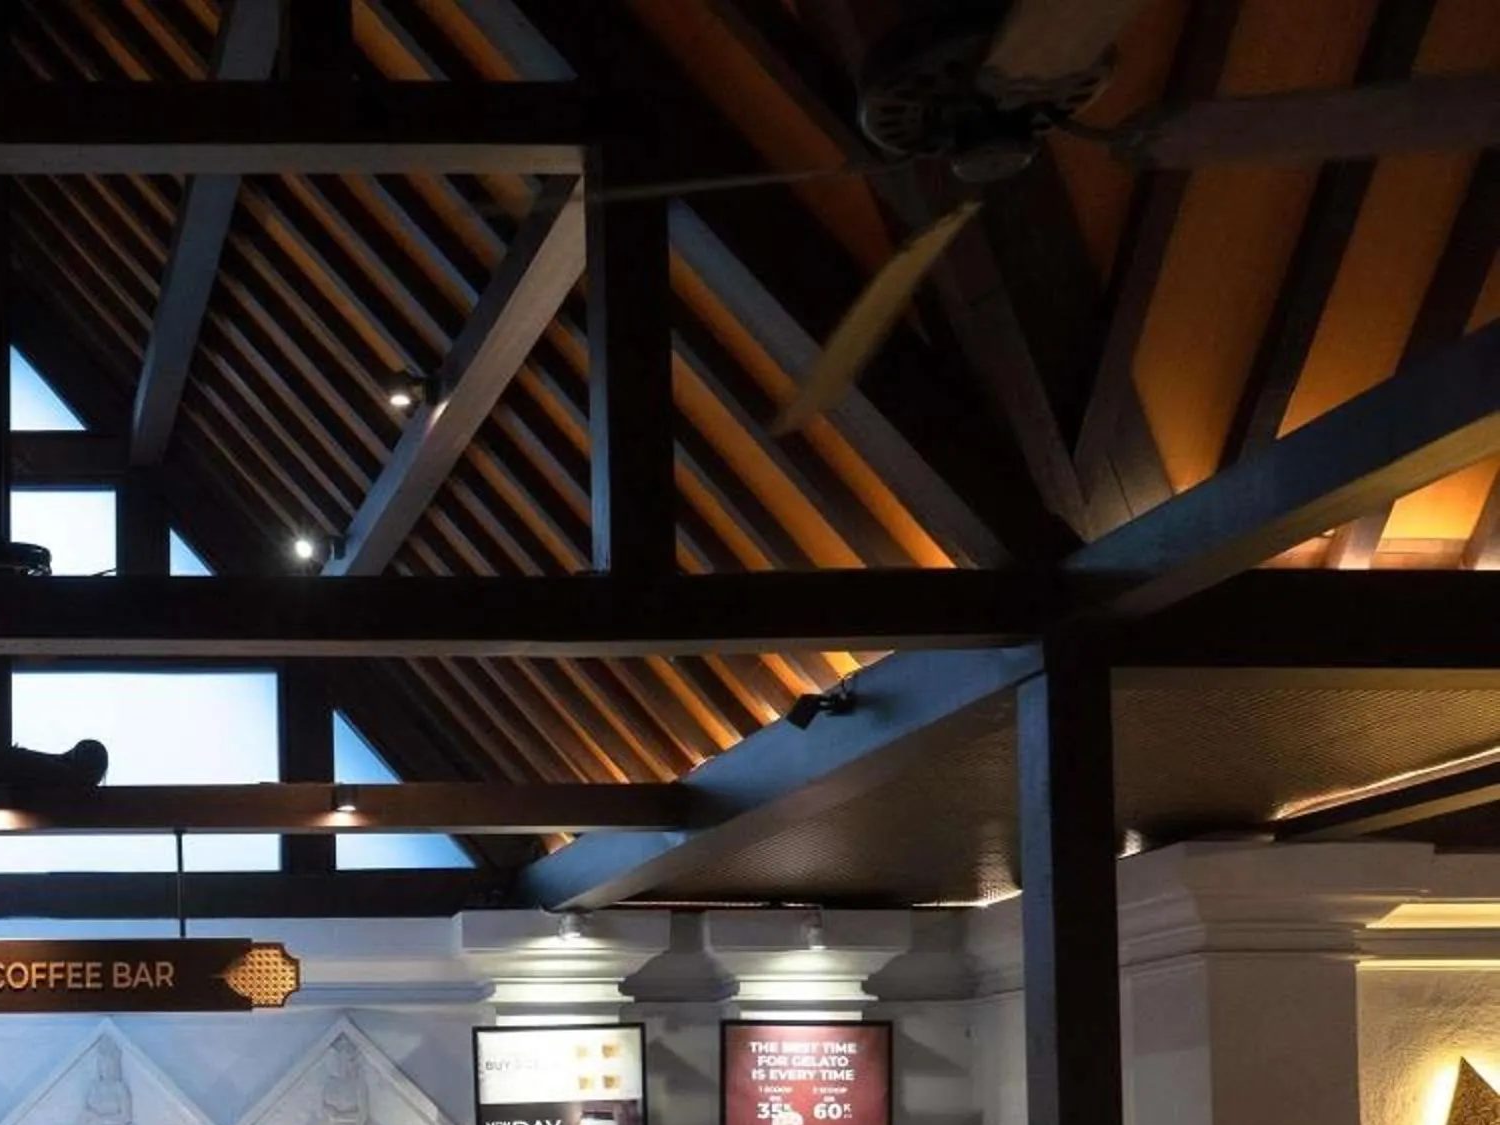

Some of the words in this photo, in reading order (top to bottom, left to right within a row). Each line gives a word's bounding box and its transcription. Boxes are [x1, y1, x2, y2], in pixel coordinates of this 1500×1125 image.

[112, 961, 175, 988] BAR
[750, 1041, 779, 1054] THE
[823, 1041, 858, 1054] TIME
[757, 1055, 789, 1068] FOR
[792, 1055, 849, 1067] GELATO
[751, 1069, 766, 1081] IS
[769, 1069, 817, 1081] EVERY
[819, 1069, 855, 1081] TIME
